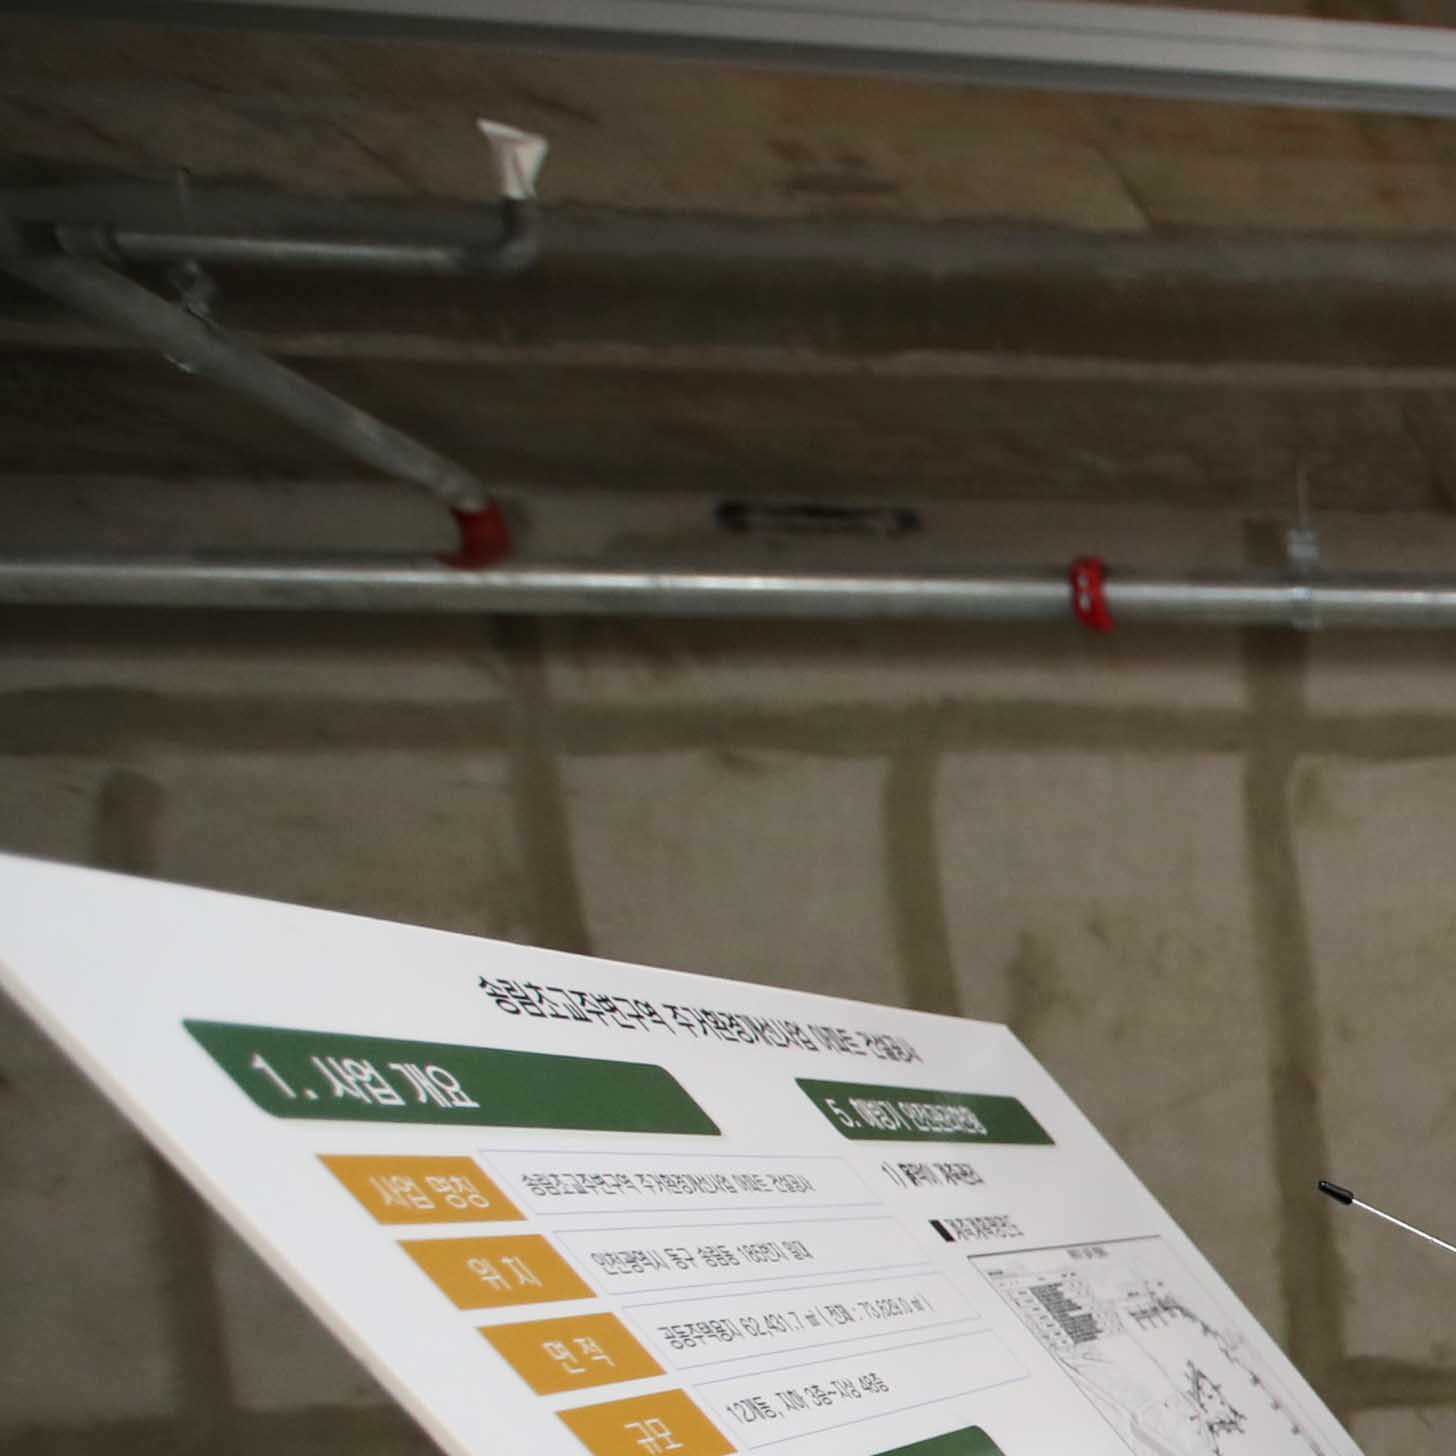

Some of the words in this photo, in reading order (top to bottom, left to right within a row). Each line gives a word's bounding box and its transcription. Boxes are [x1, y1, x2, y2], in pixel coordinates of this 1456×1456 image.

[478, 976, 675, 1034] 송림초교주변구역
[250, 1052, 319, 1100] 1.
[311, 1055, 406, 1106] 사업
[388, 1061, 480, 1108] 개요
[824, 1098, 861, 1127] 5.
[370, 1175, 434, 1208] 사업
[424, 1176, 489, 1208] 명칭
[590, 1249, 670, 1275] 인천광역시
[663, 1247, 694, 1270] 동구
[697, 1244, 740, 1267] 송림동
[656, 1317, 743, 1350] 공동주택용지
[738, 1311, 803, 1337] 62,431.7
[726, 1395, 783, 1423] 12개동,
[774, 1389, 809, 1410] 지하
[623, 1417, 683, 1454] 규모
